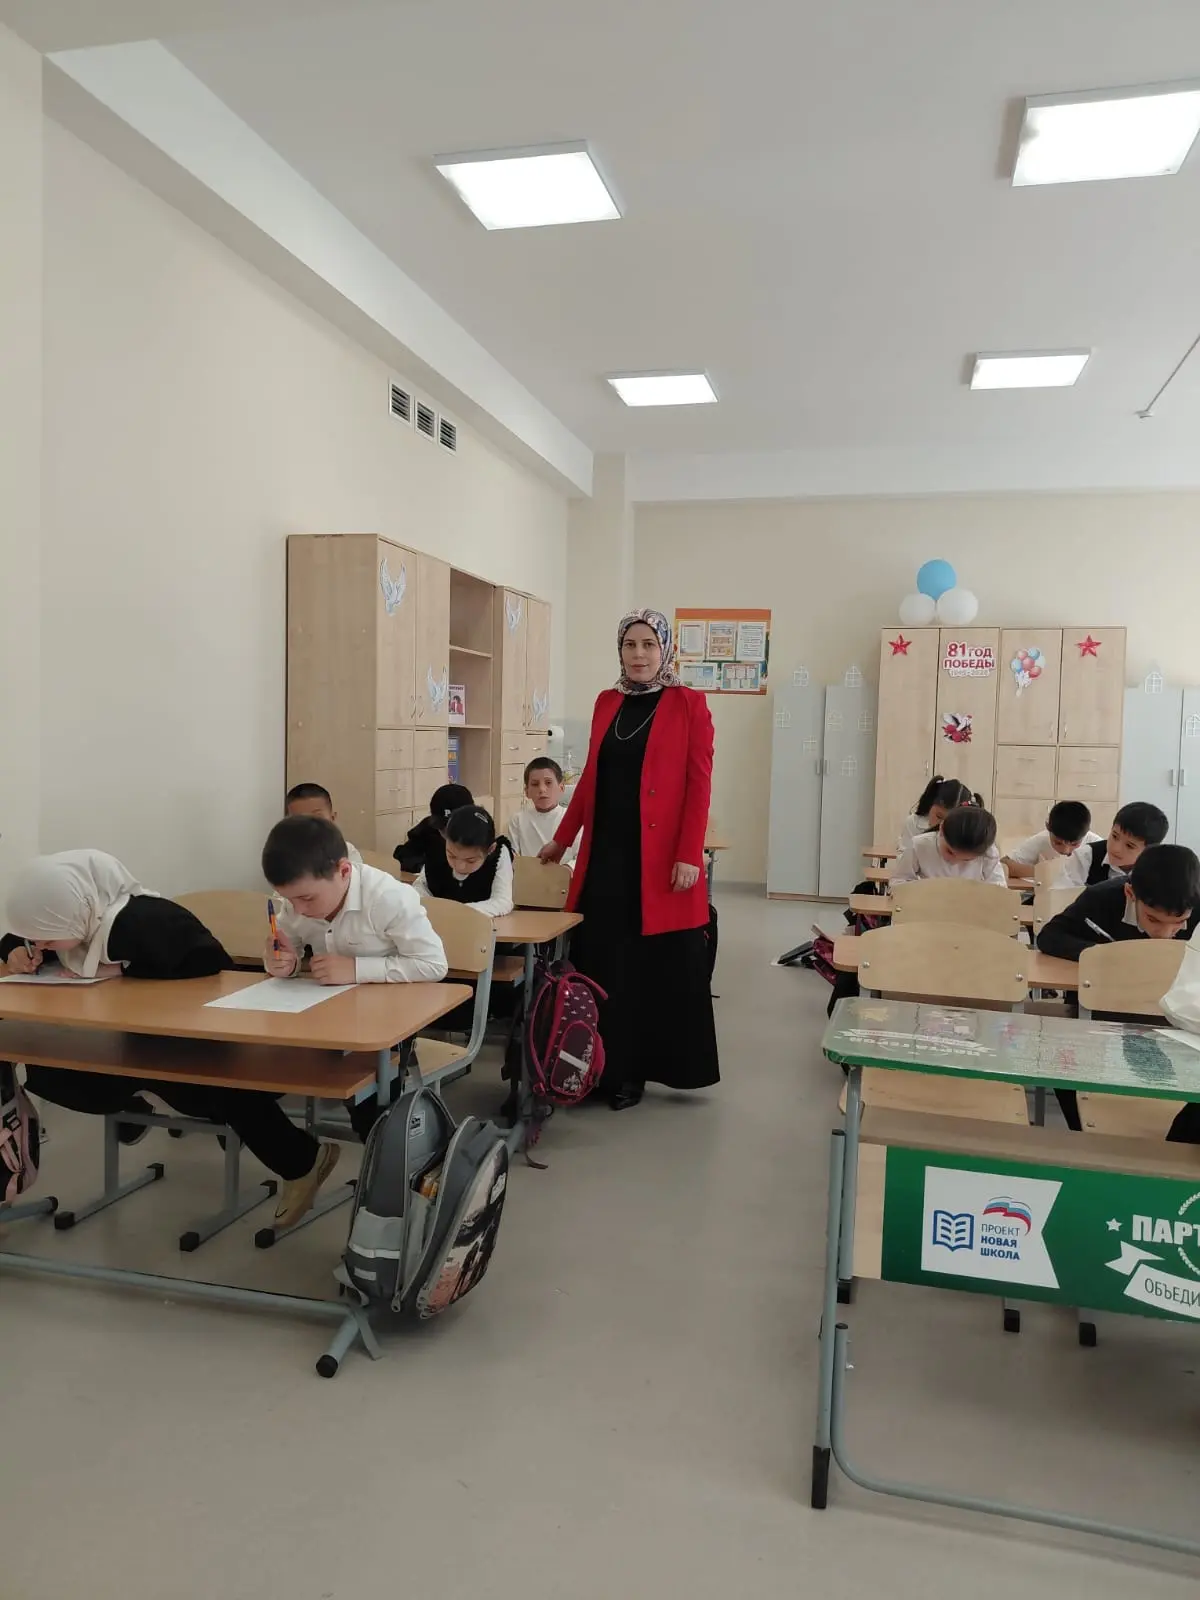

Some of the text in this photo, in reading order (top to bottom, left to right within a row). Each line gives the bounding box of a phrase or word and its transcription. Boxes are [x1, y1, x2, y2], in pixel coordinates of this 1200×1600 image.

[948, 643, 993, 658] 81 ГОД
[944, 659, 995, 669] ПОБЕДЫ
[981, 1223, 1020, 1236] ПРОЕКТ
[980, 1235, 1017, 1248] НОВАЯ
[980, 1247, 1021, 1260] ШКОЛА
